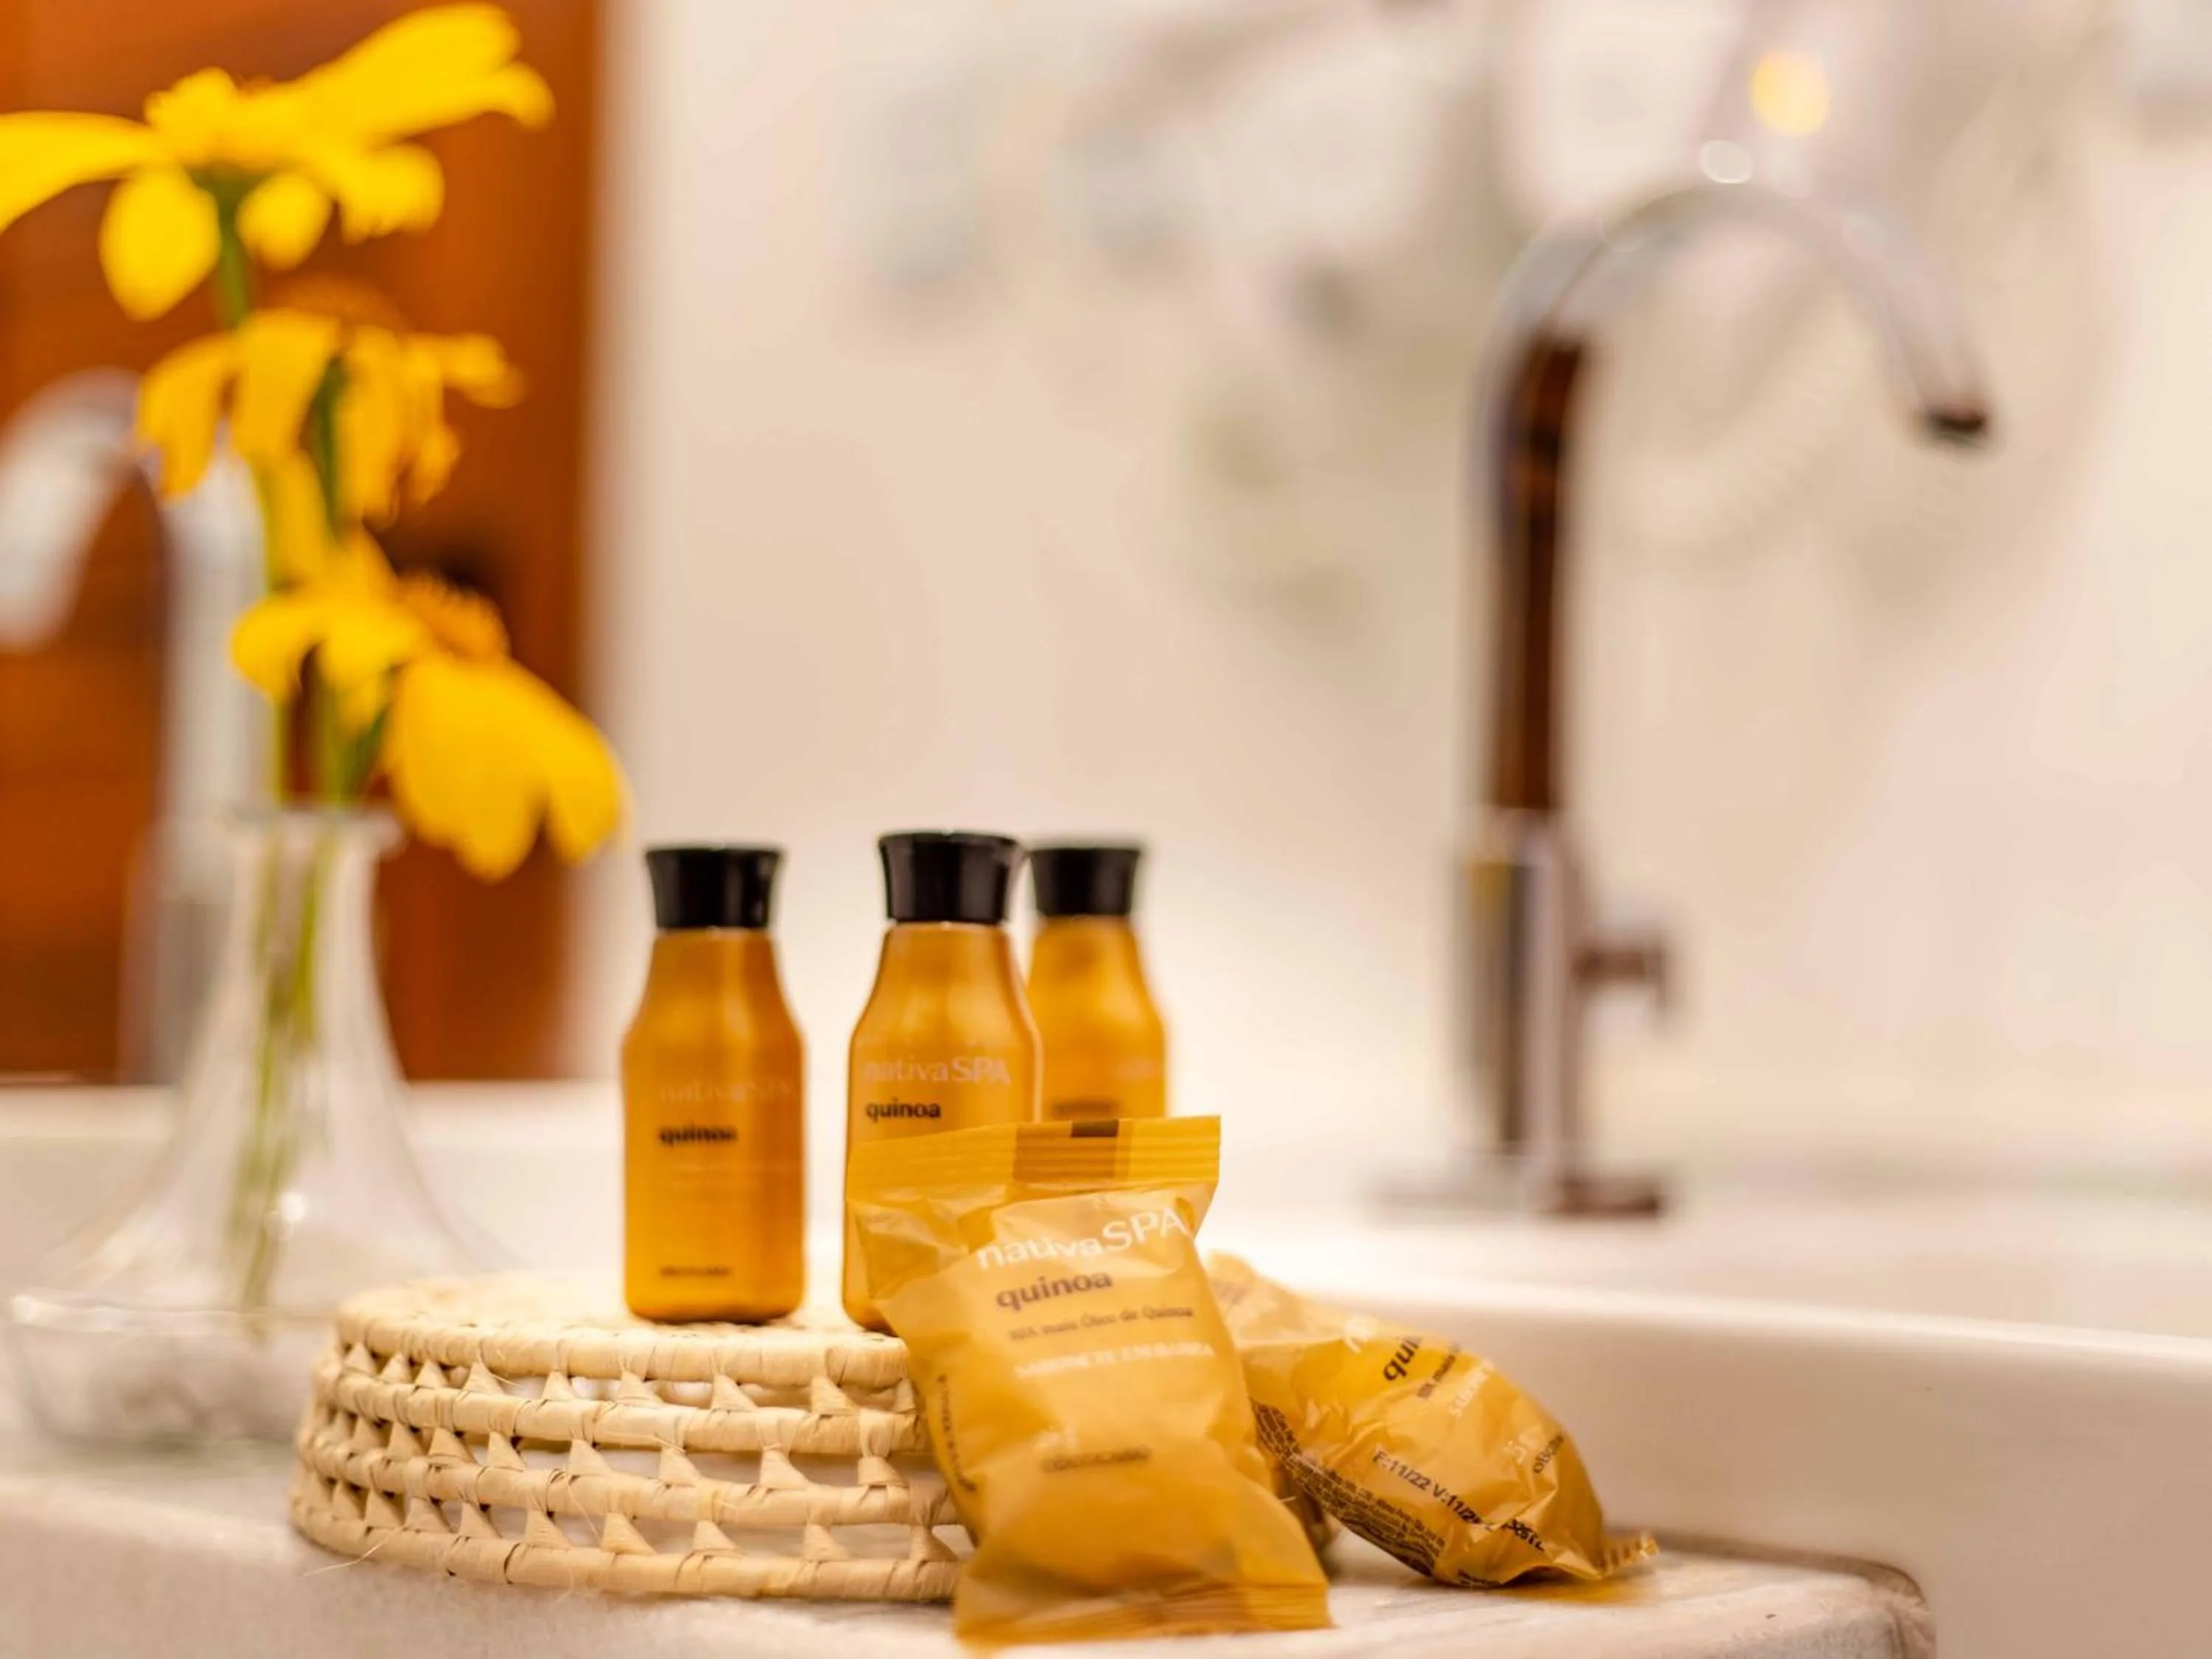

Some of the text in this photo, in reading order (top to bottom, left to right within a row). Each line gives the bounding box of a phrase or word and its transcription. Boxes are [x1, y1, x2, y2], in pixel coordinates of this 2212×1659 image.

[866, 1096, 942, 1123] quinoa
[977, 1207, 1191, 1269] nativaSPA
[995, 1272, 1113, 1311] quinoa
[1372, 1450, 1431, 1492] F:11/22
